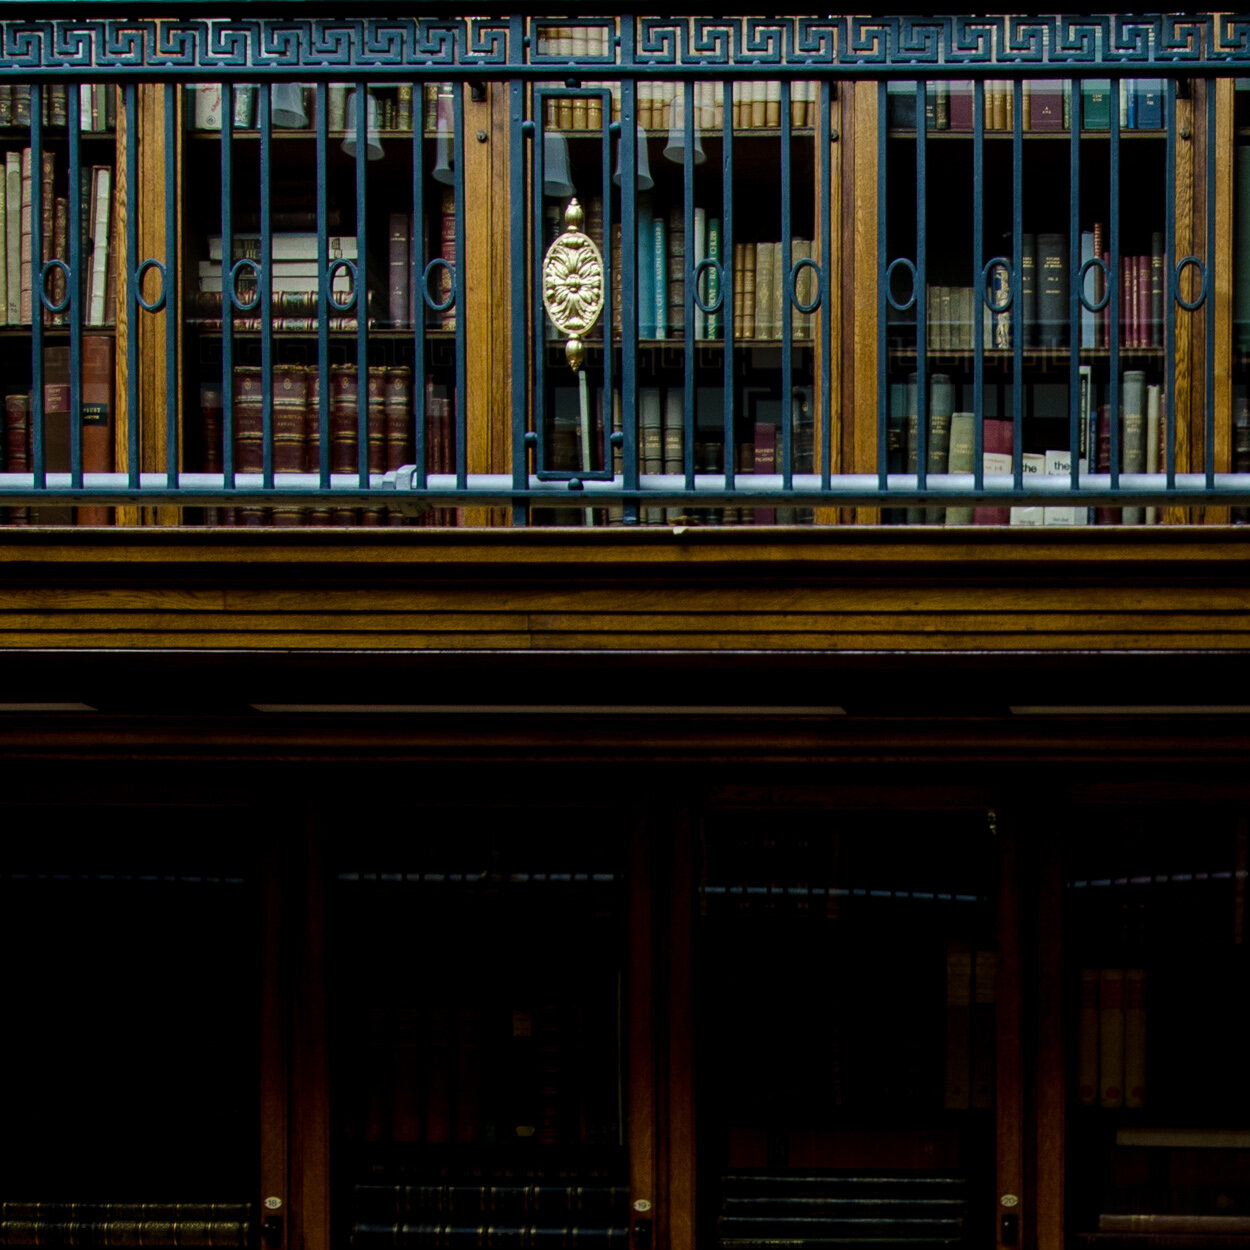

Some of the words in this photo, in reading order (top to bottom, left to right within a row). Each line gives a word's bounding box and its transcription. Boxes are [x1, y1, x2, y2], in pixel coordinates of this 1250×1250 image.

[1054, 461, 1070, 471] the
[268, 1199, 277, 1208] 18
[638, 1202, 647, 1210] 19
